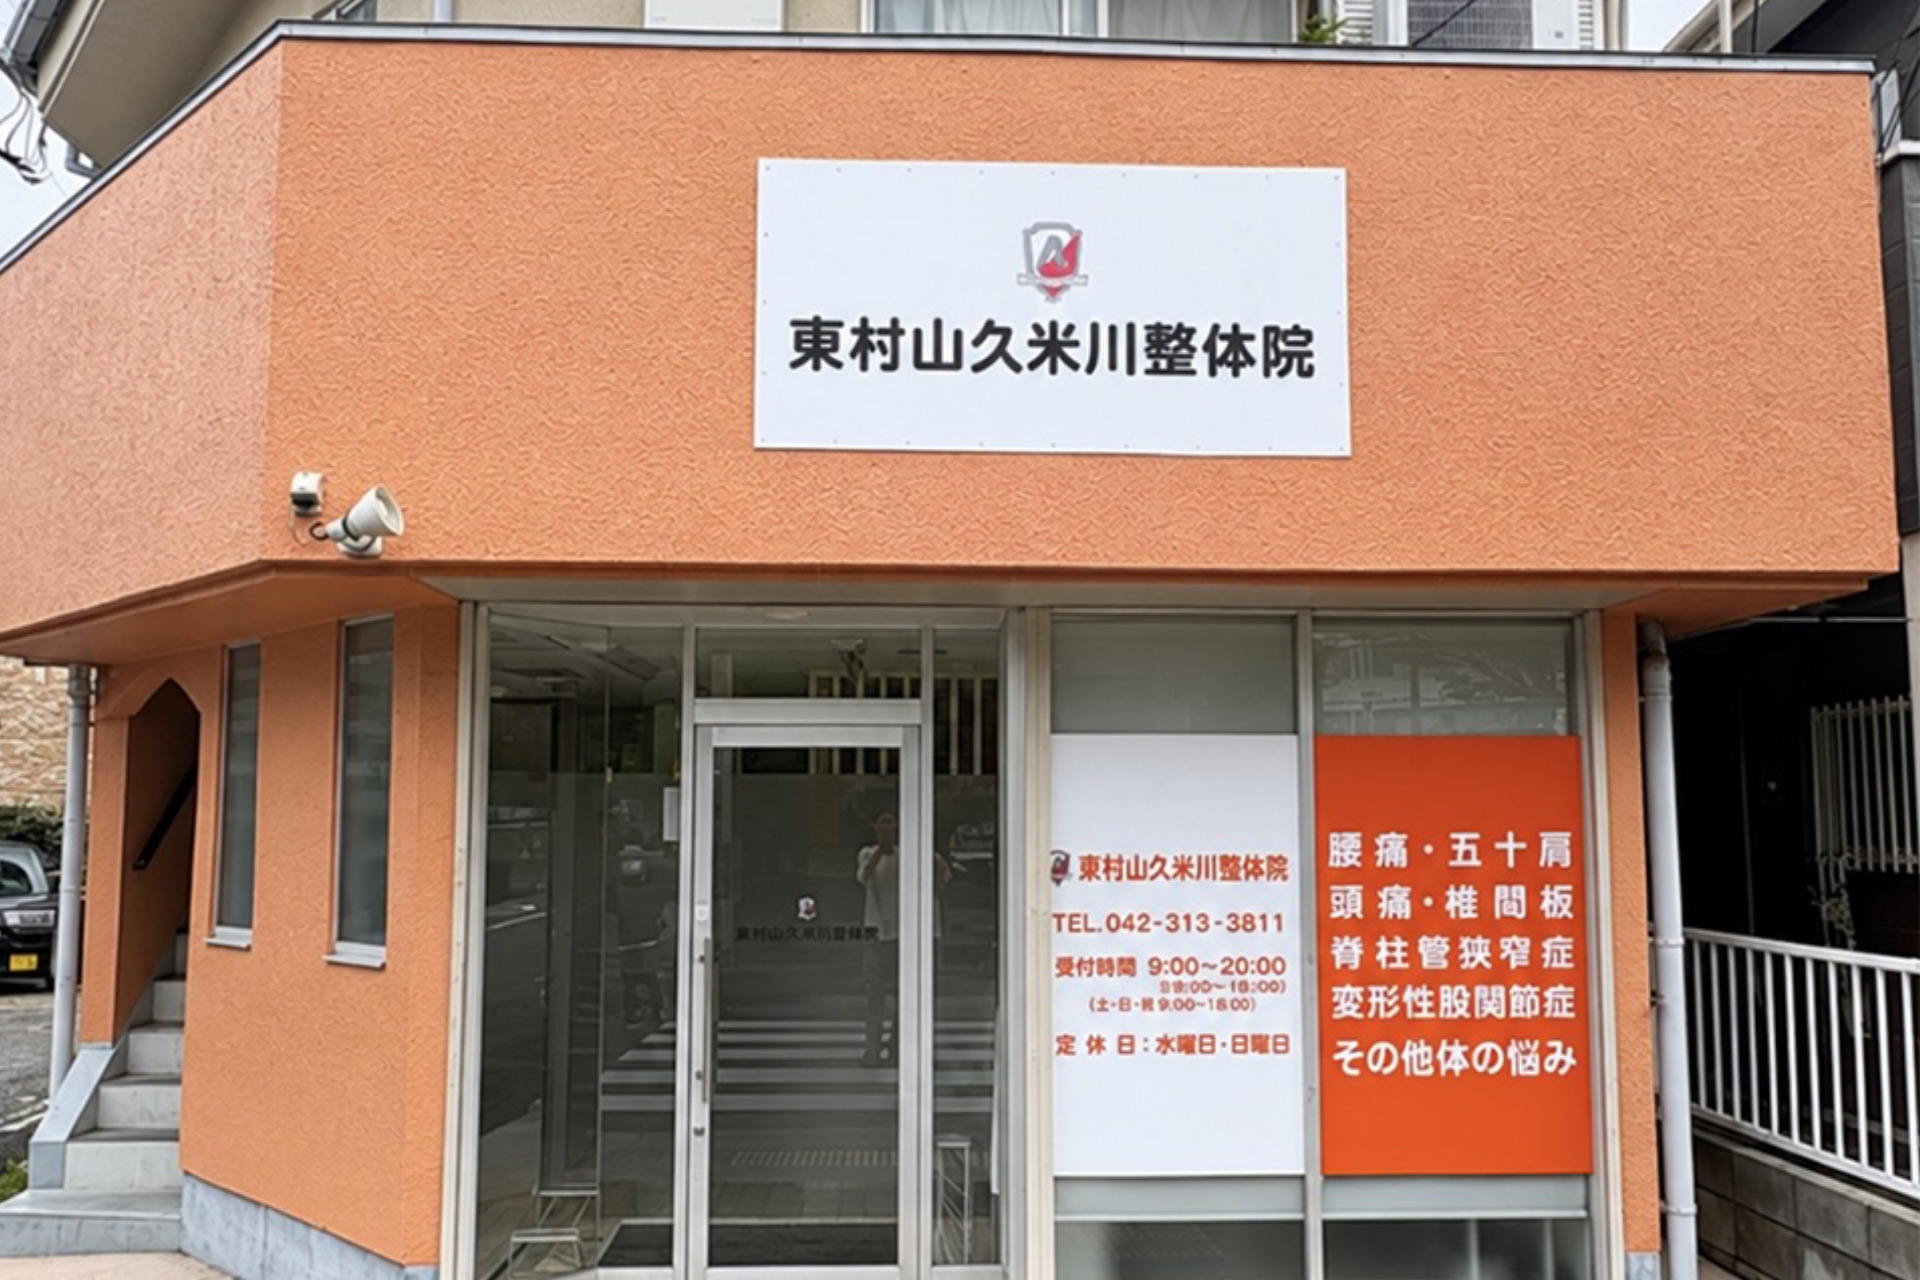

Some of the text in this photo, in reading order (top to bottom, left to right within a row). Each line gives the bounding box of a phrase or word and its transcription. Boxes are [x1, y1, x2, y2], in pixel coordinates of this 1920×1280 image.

[789, 315, 1315, 378] 東村山久米川整体院
[1328, 831, 1571, 868] 腰痛・五十肩
[1078, 853, 1289, 883] 東村山久米川整体院
[1329, 884, 1573, 920] 頭痛・椎間板
[1055, 956, 1137, 977] 受付時間
[1331, 934, 1575, 970] 脊柱管狭窄症
[1332, 983, 1576, 1020] 変形性股関節症
[1332, 1038, 1577, 1077] その他体の悩み
